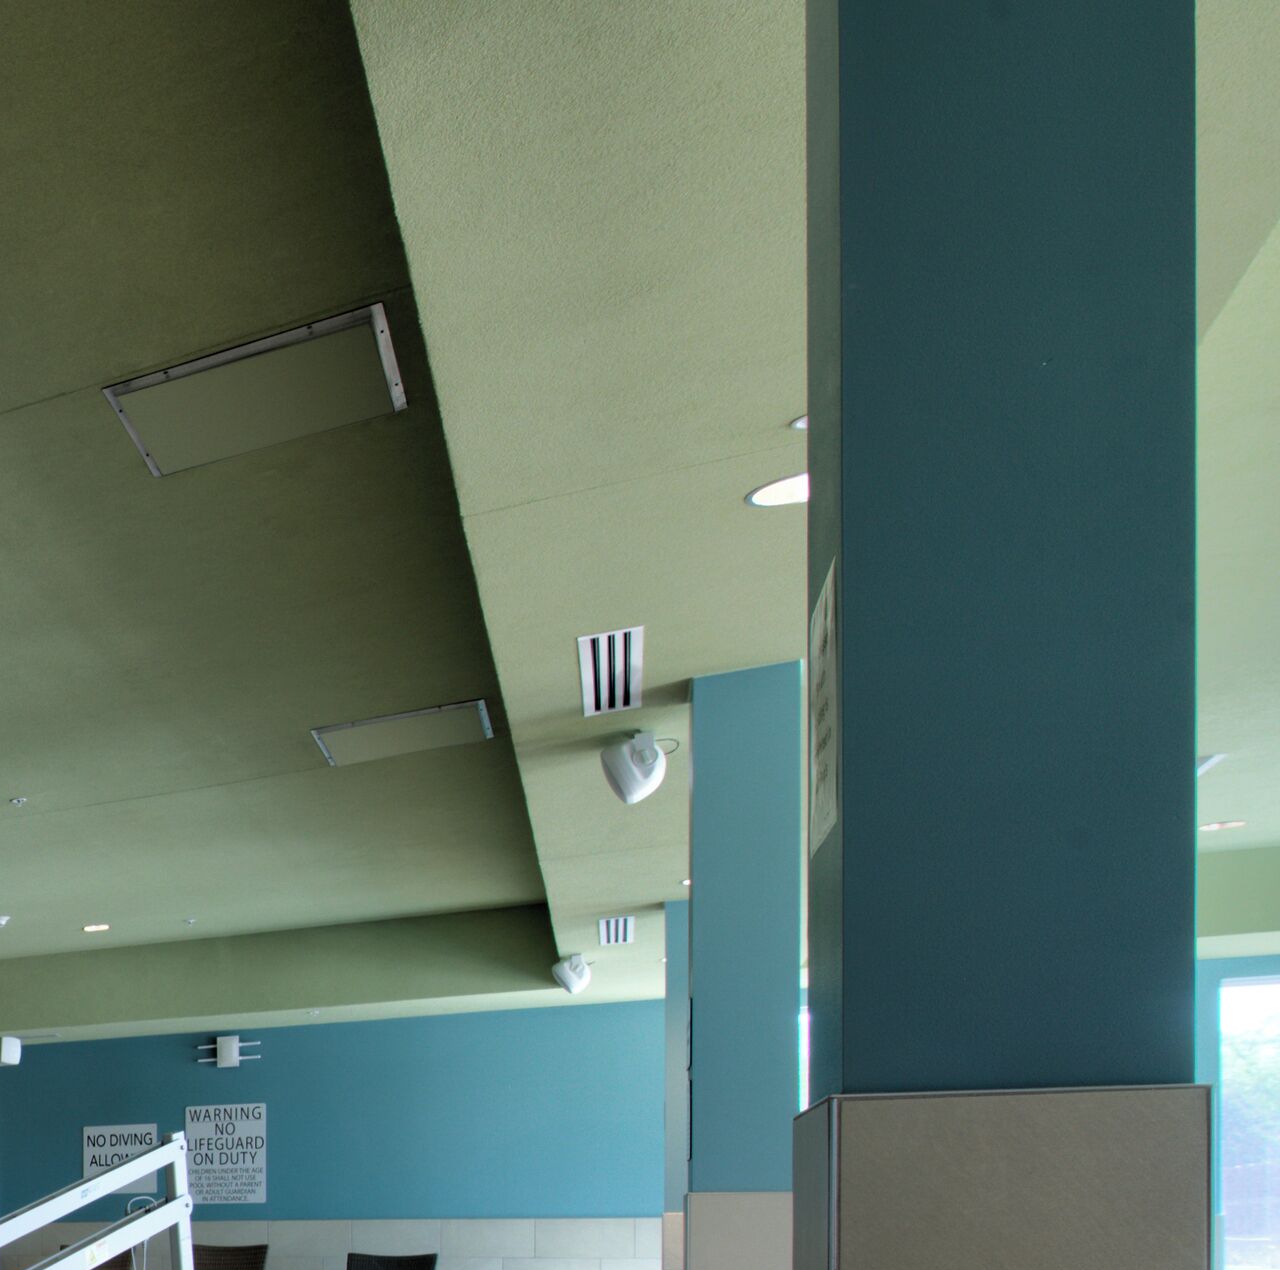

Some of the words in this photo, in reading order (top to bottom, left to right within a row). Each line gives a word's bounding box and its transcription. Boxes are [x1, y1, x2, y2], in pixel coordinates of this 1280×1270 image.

[189, 1106, 262, 1122] WARNING
[214, 1122, 236, 1136] NO
[87, 1134, 106, 1148] NO
[110, 1132, 153, 1147] DIVING
[187, 1136, 264, 1152] LIFEGUARD
[90, 1153, 133, 1167] ALLOW
[193, 1152, 214, 1166] ON
[219, 1151, 257, 1165] DUTY
